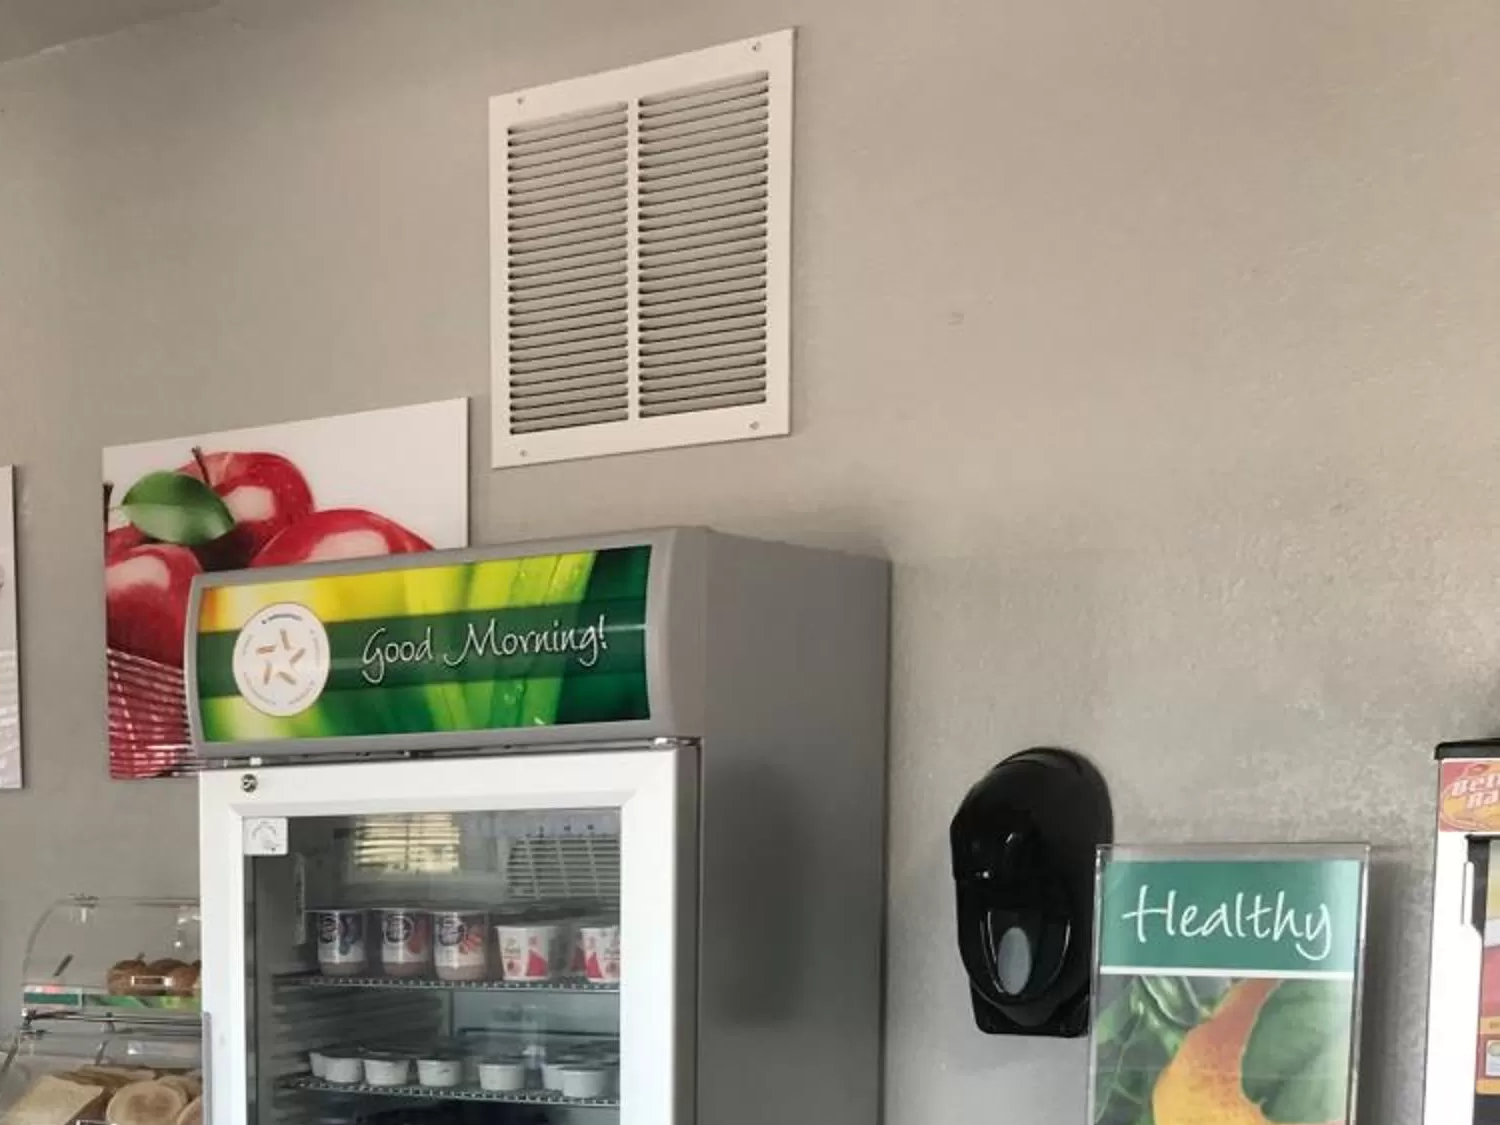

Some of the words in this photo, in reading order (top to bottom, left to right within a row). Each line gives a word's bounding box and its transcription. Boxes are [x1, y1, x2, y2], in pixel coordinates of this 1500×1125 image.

[361, 626, 434, 685] Good
[443, 613, 608, 668] Morning!
[1121, 884, 1333, 961] Healthy
